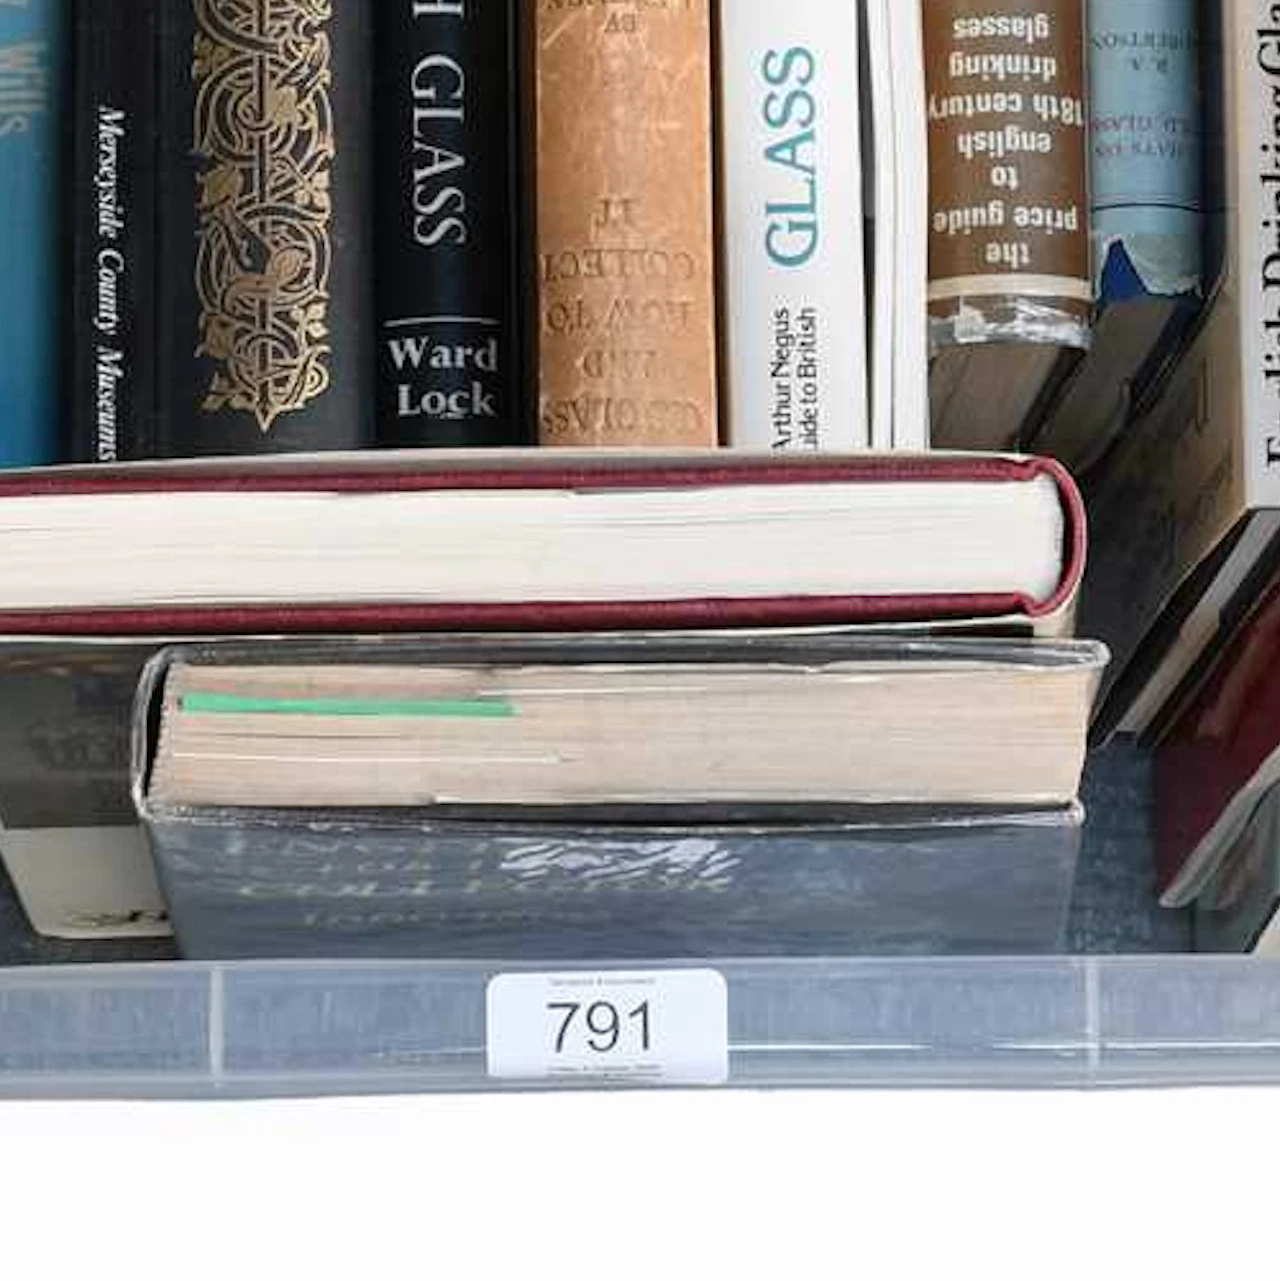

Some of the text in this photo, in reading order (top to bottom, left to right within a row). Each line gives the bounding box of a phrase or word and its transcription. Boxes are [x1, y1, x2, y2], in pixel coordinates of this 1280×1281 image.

[953, 12, 1048, 43] glasses
[949, 52, 1055, 81] drinking
[929, 92, 1084, 125] 18th century
[412, 53, 465, 247] GLASS
[762, 46, 818, 268] GLASS
[957, 126, 1052, 158] english
[992, 165, 1018, 191] to
[933, 201, 1078, 236] price guide
[985, 241, 1030, 267] the
[91, 106, 126, 462] Merseyside County Museums
[388, 336, 498, 373] Ward
[771, 306, 794, 378] Negus
[796, 308, 817, 378] British
[397, 383, 495, 419] Lock
[800, 383, 817, 404] to
[548, 1001, 650, 1053] 791
